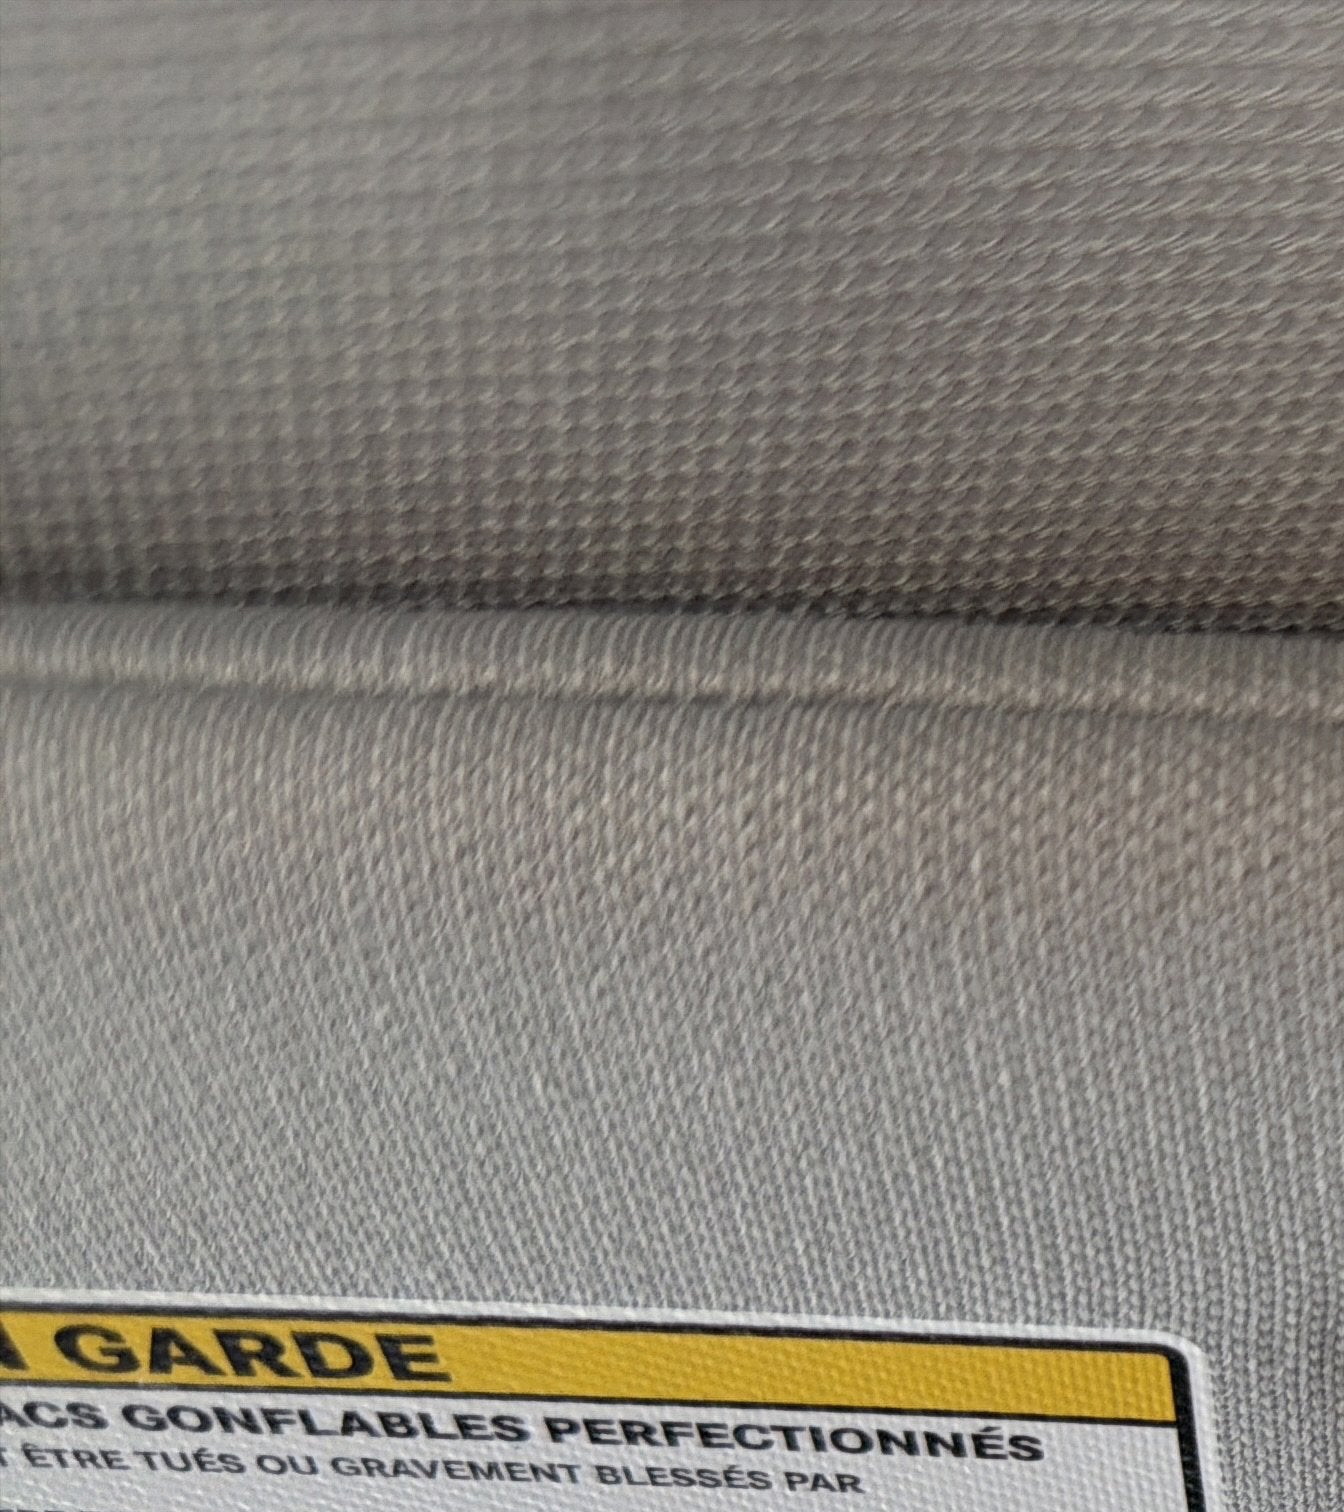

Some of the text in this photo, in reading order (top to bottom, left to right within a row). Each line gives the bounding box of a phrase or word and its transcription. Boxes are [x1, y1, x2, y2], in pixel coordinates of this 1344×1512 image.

[53, 1324, 453, 1383] GARDE
[121, 1404, 532, 1443] GONFLABLES
[543, 1416, 1045, 1462] PERFECTIONNÉS
[22, 1443, 131, 1471] ÊTRE
[133, 1447, 247, 1475] TUÉS
[256, 1454, 321, 1477] OU
[330, 1456, 582, 1485] GRAVEMENT
[597, 1464, 770, 1492] BLESSÉS
[784, 1471, 865, 1495] PAR
